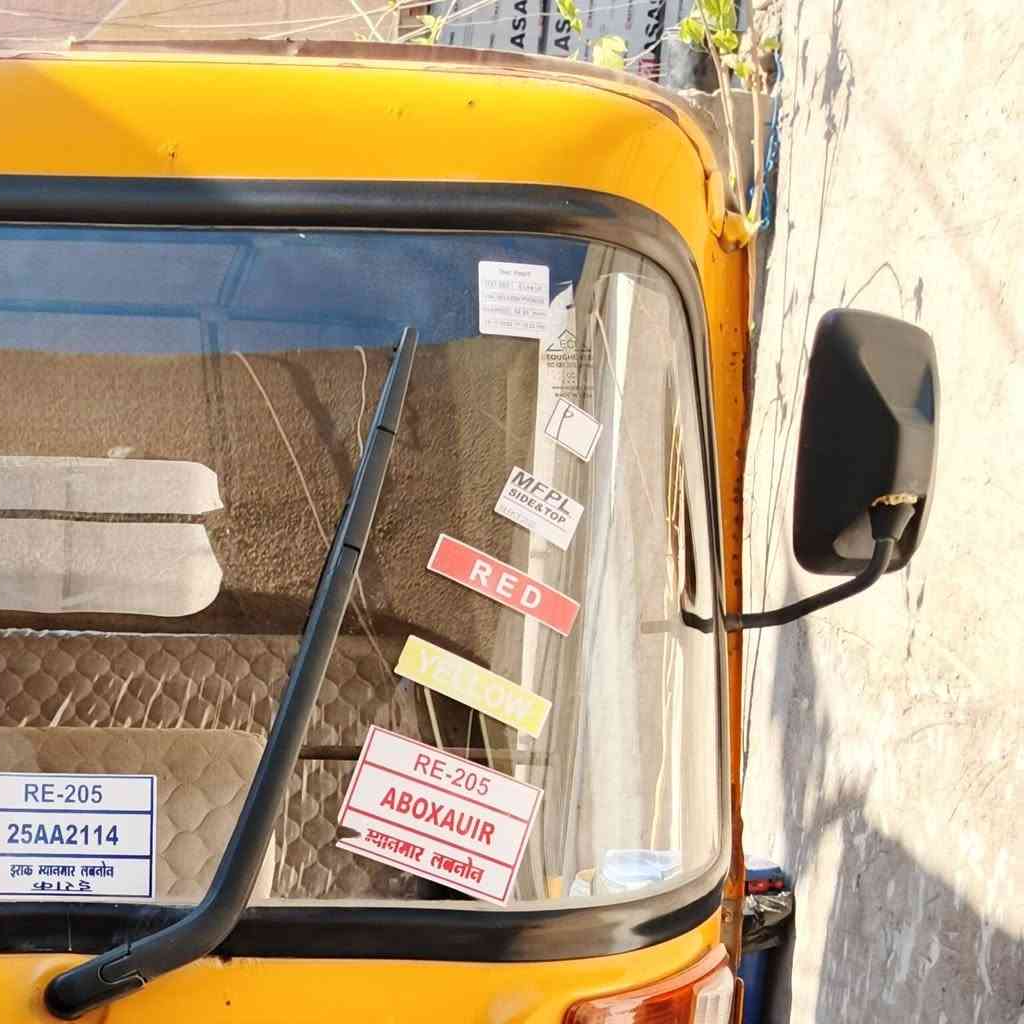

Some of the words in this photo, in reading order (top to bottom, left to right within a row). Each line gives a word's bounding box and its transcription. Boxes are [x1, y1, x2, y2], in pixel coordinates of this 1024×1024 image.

[509, 488, 567, 523] SIDE&TOP
[512, 471, 570, 515] MFPL
[468, 559, 542, 610] RED
[24, 783, 103, 804] RE-205
[414, 753, 491, 796] RE-205
[7, 823, 119, 846] 25AA2114
[380, 786, 495, 846] ABOXAUIR
